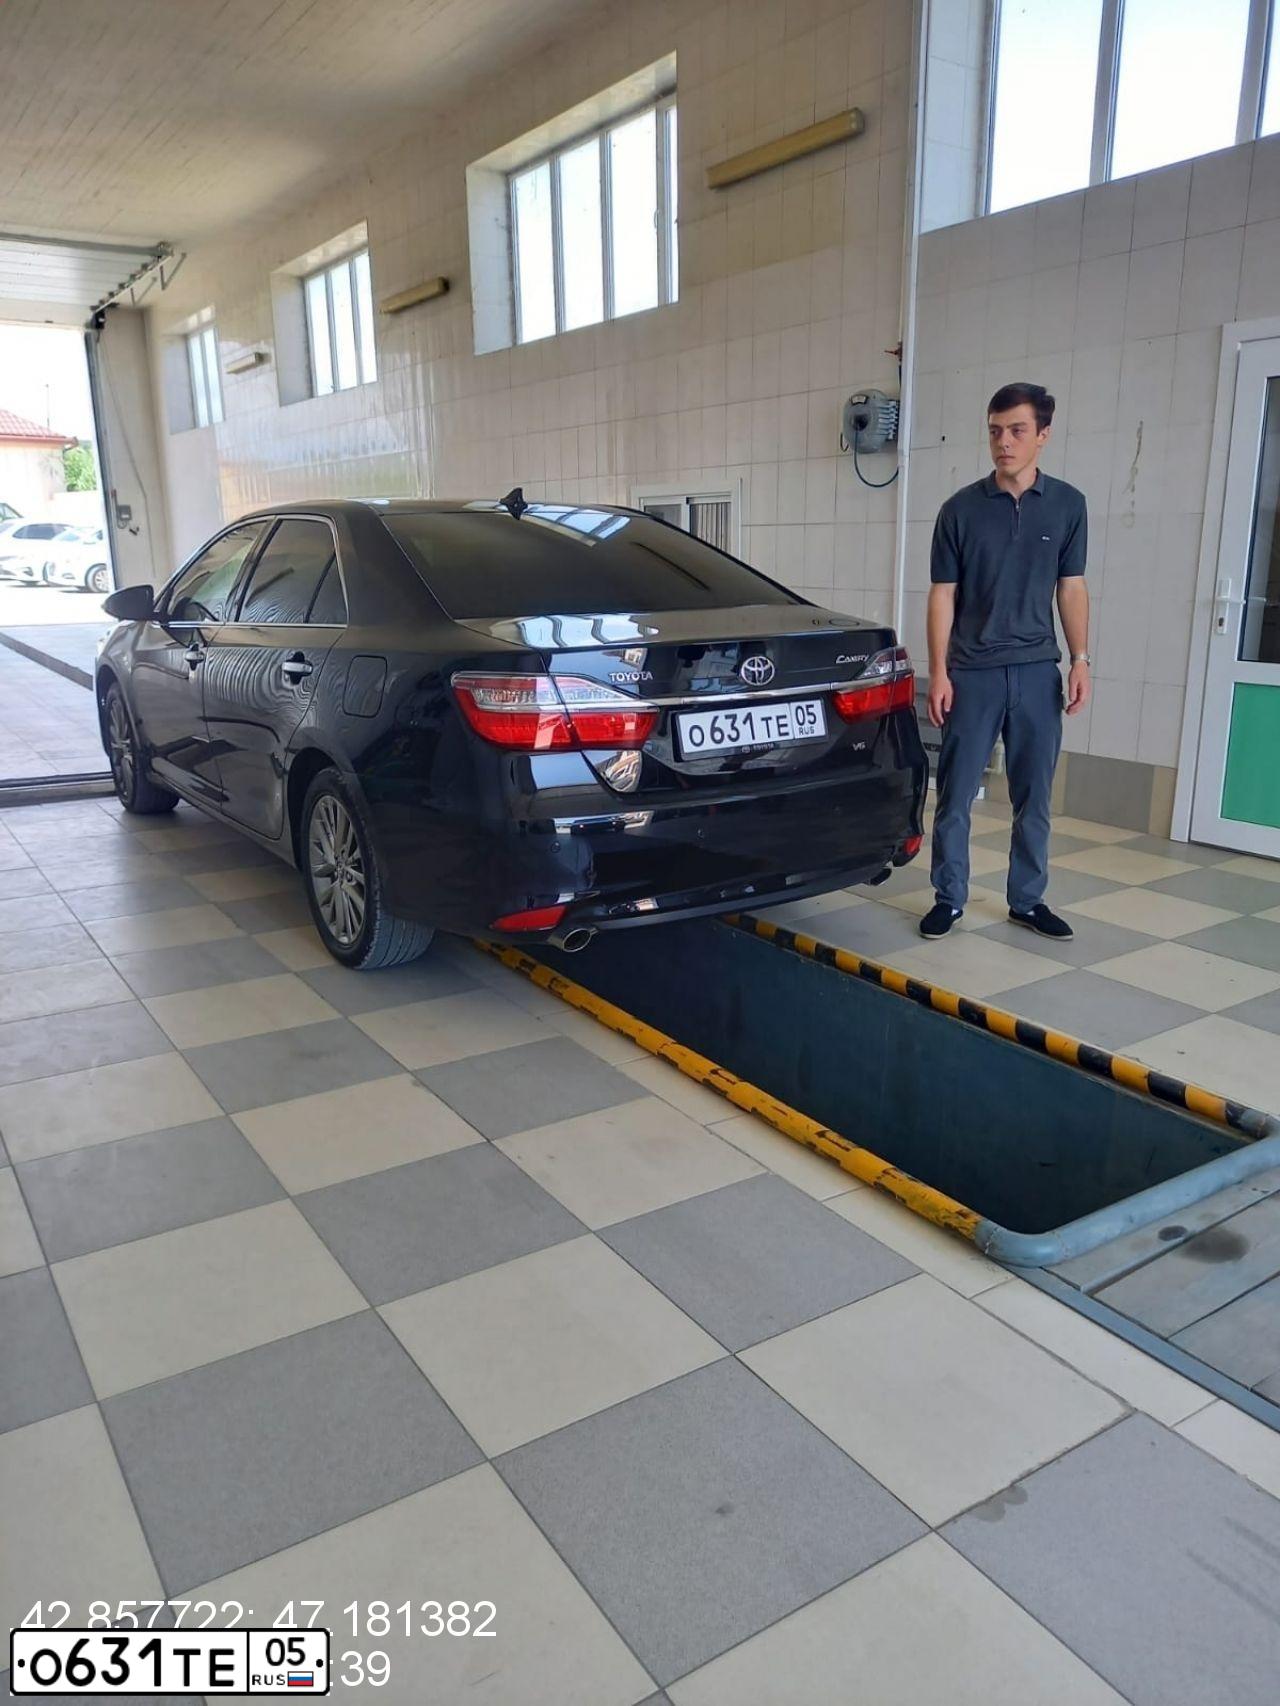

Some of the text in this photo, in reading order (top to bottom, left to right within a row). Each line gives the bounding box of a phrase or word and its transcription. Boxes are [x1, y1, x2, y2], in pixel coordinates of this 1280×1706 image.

[609, 672, 653, 682] TOYOTA
[795, 704, 817, 726] 05
[799, 726, 815, 736] RUS
